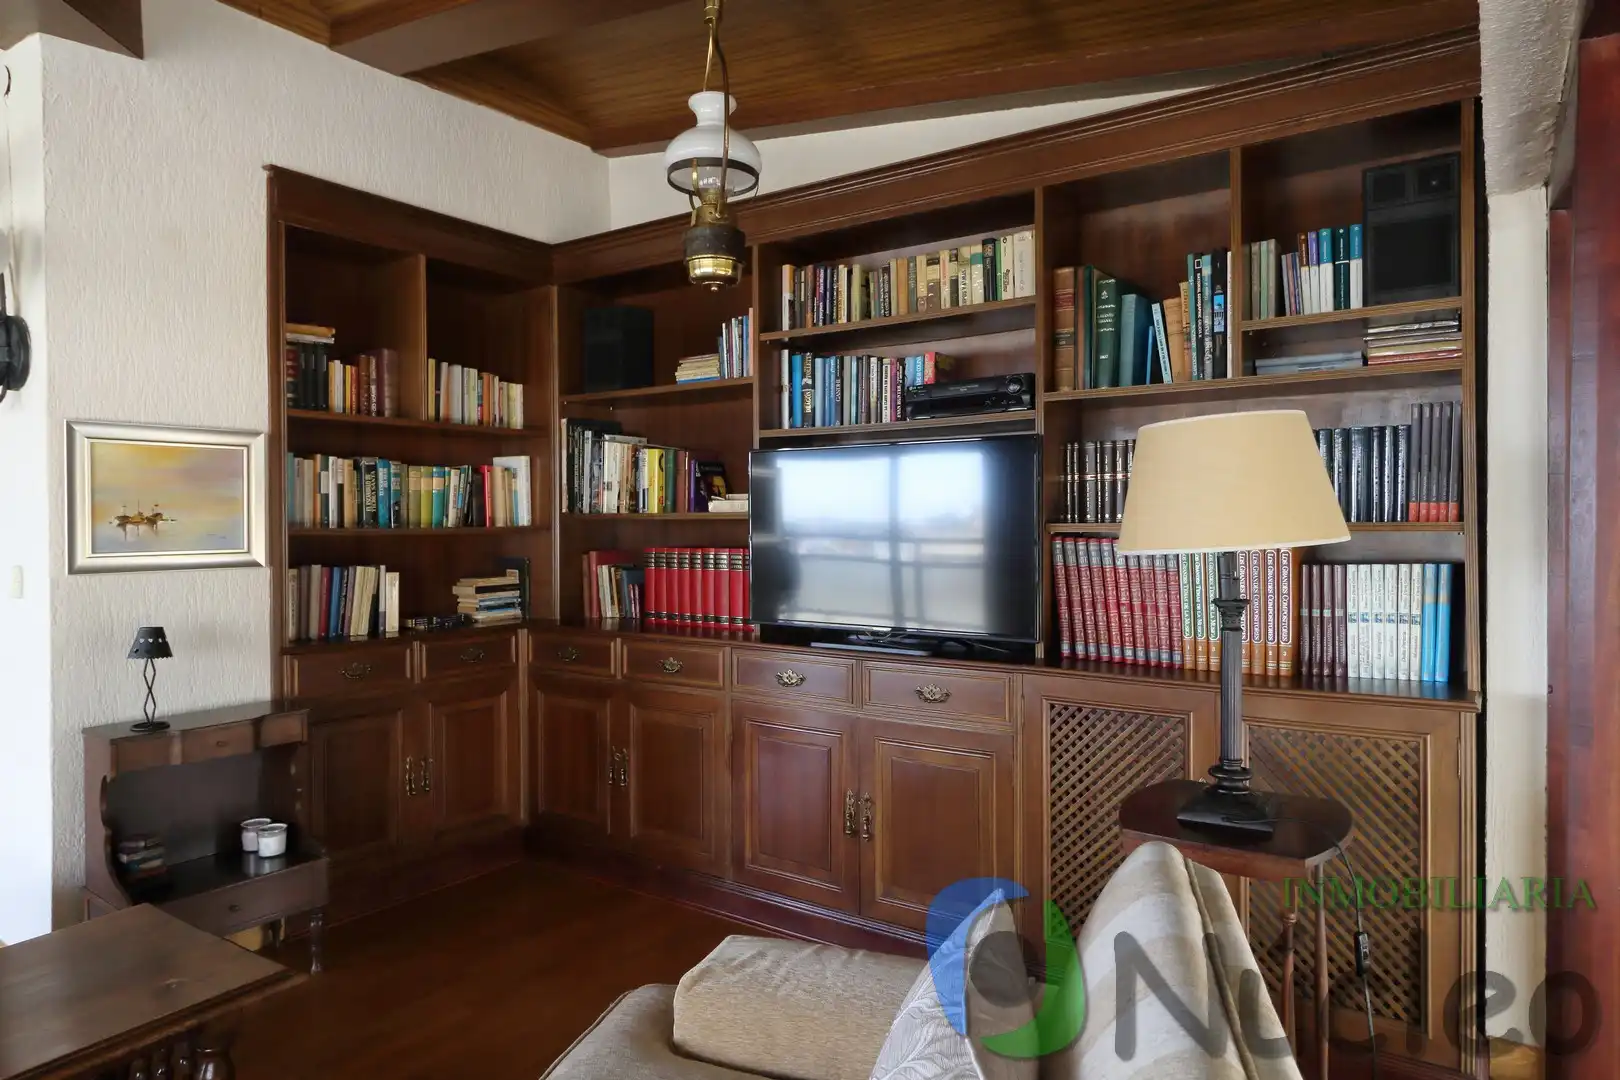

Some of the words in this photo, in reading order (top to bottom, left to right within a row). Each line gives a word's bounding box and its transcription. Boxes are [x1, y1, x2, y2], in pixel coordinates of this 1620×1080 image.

[1252, 565, 1260, 594] GRANDES
[1267, 566, 1275, 594] GRANDES
[1282, 566, 1290, 594] GRANDES
[1282, 594, 1290, 642] COMPOSITORES
